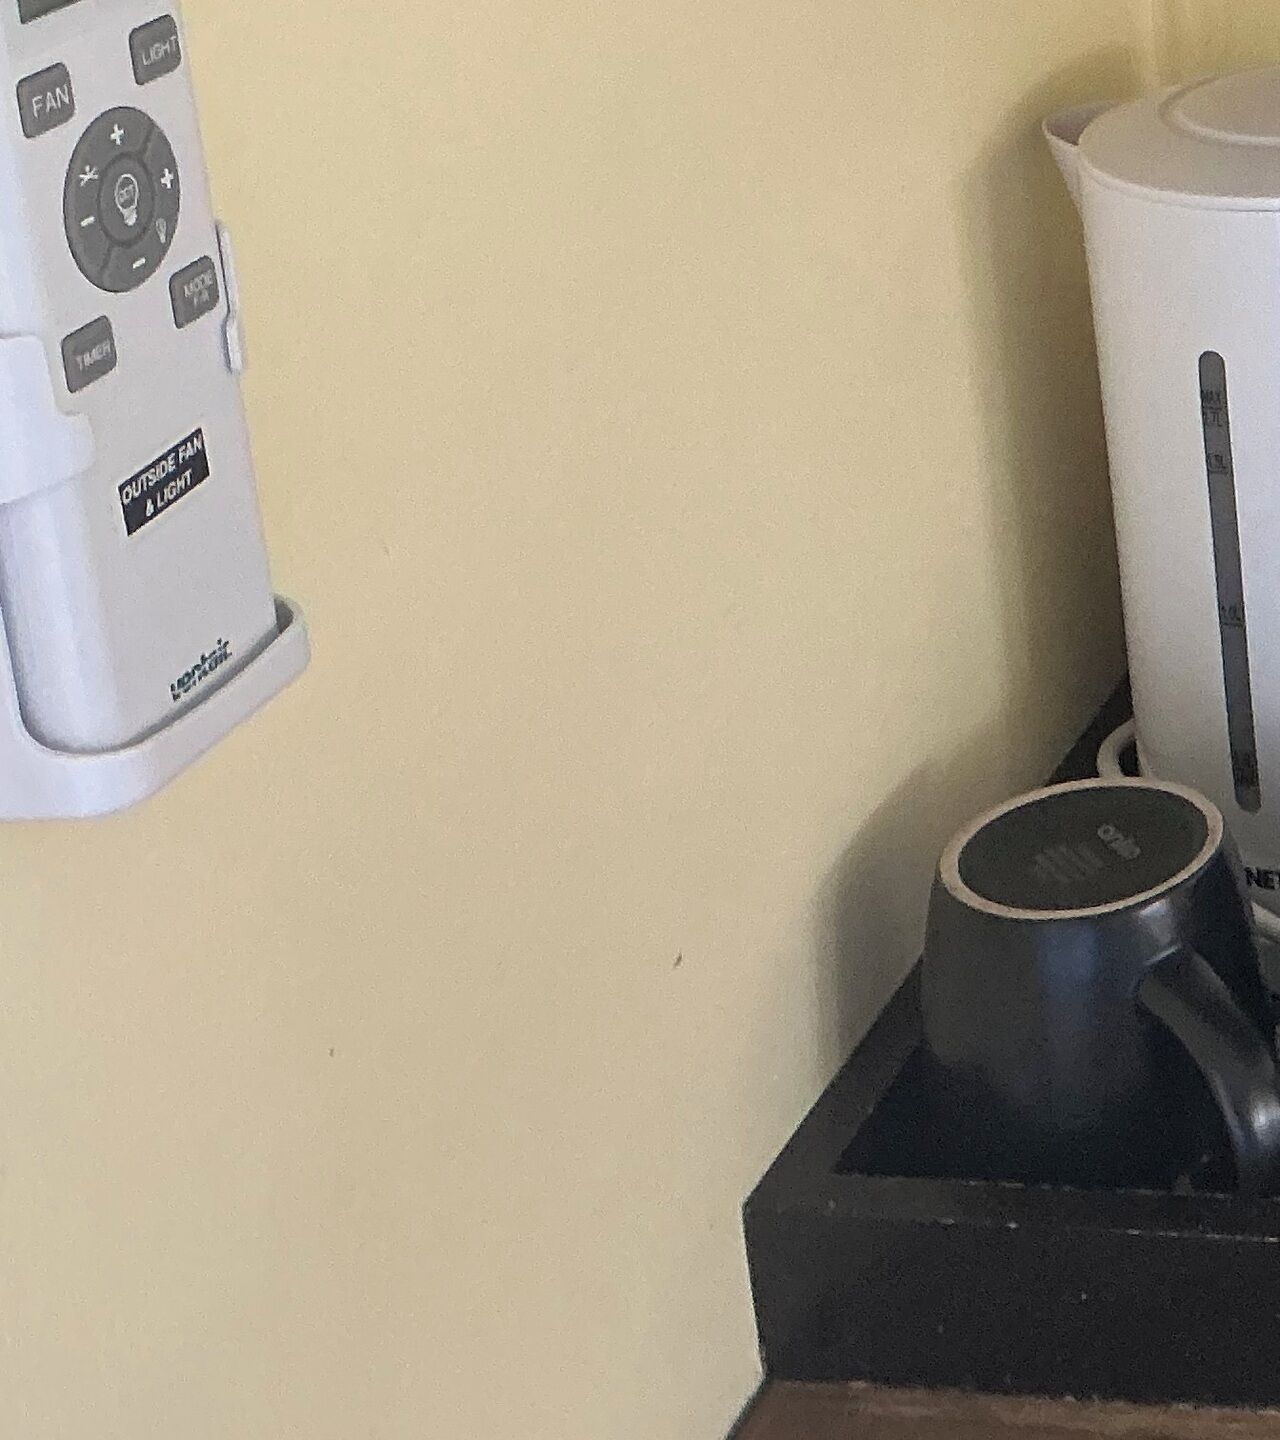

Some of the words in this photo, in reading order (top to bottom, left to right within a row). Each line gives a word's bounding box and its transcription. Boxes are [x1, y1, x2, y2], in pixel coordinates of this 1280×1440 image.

[140, 35, 178, 68] LIGHT
[31, 84, 70, 119] FAN
[121, 451, 177, 506] OUTSIDE
[178, 433, 202, 466] FAN
[145, 496, 155, 518] &
[156, 468, 193, 509] LIGHT
